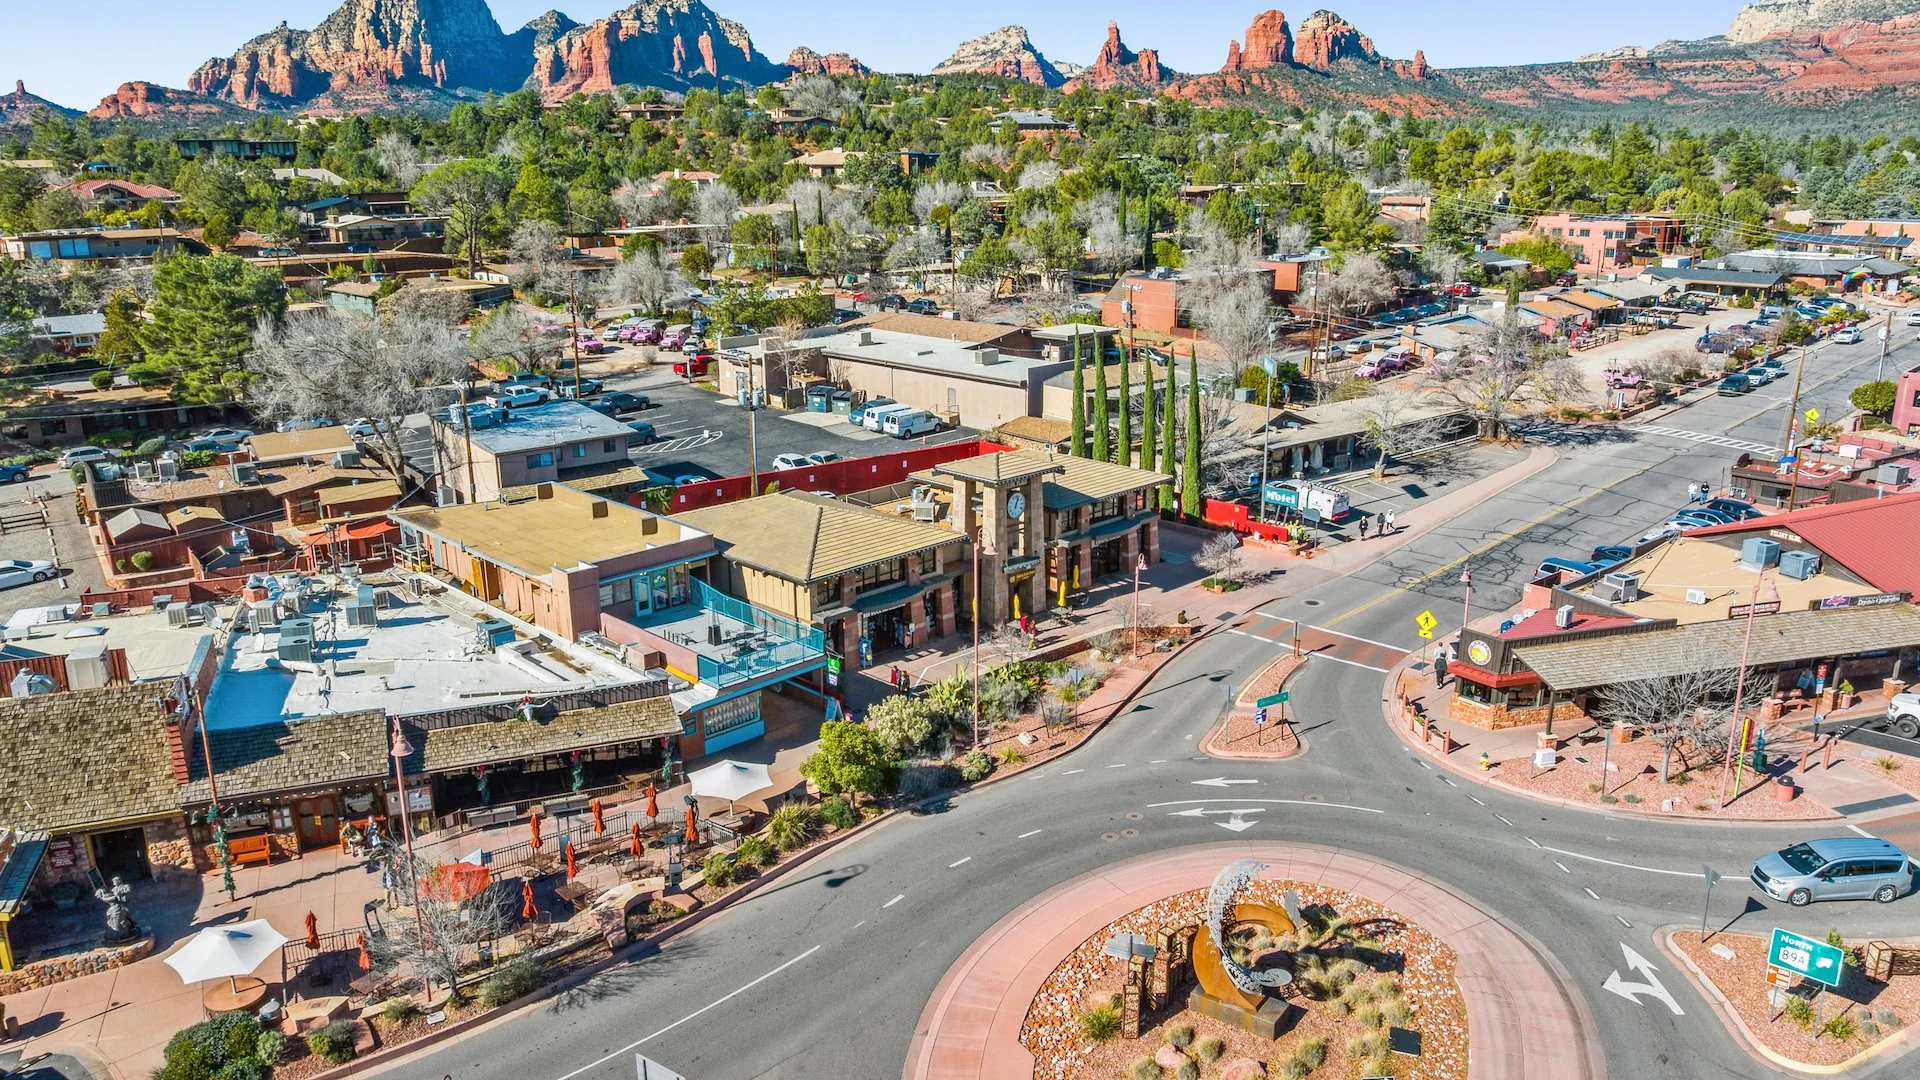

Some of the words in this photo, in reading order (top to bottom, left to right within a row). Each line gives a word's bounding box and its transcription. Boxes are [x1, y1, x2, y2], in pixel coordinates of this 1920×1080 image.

[1266, 490, 1296, 505] Motel
[1745, 603, 1769, 611] FDGE
[1781, 949, 1805, 965] 89A
